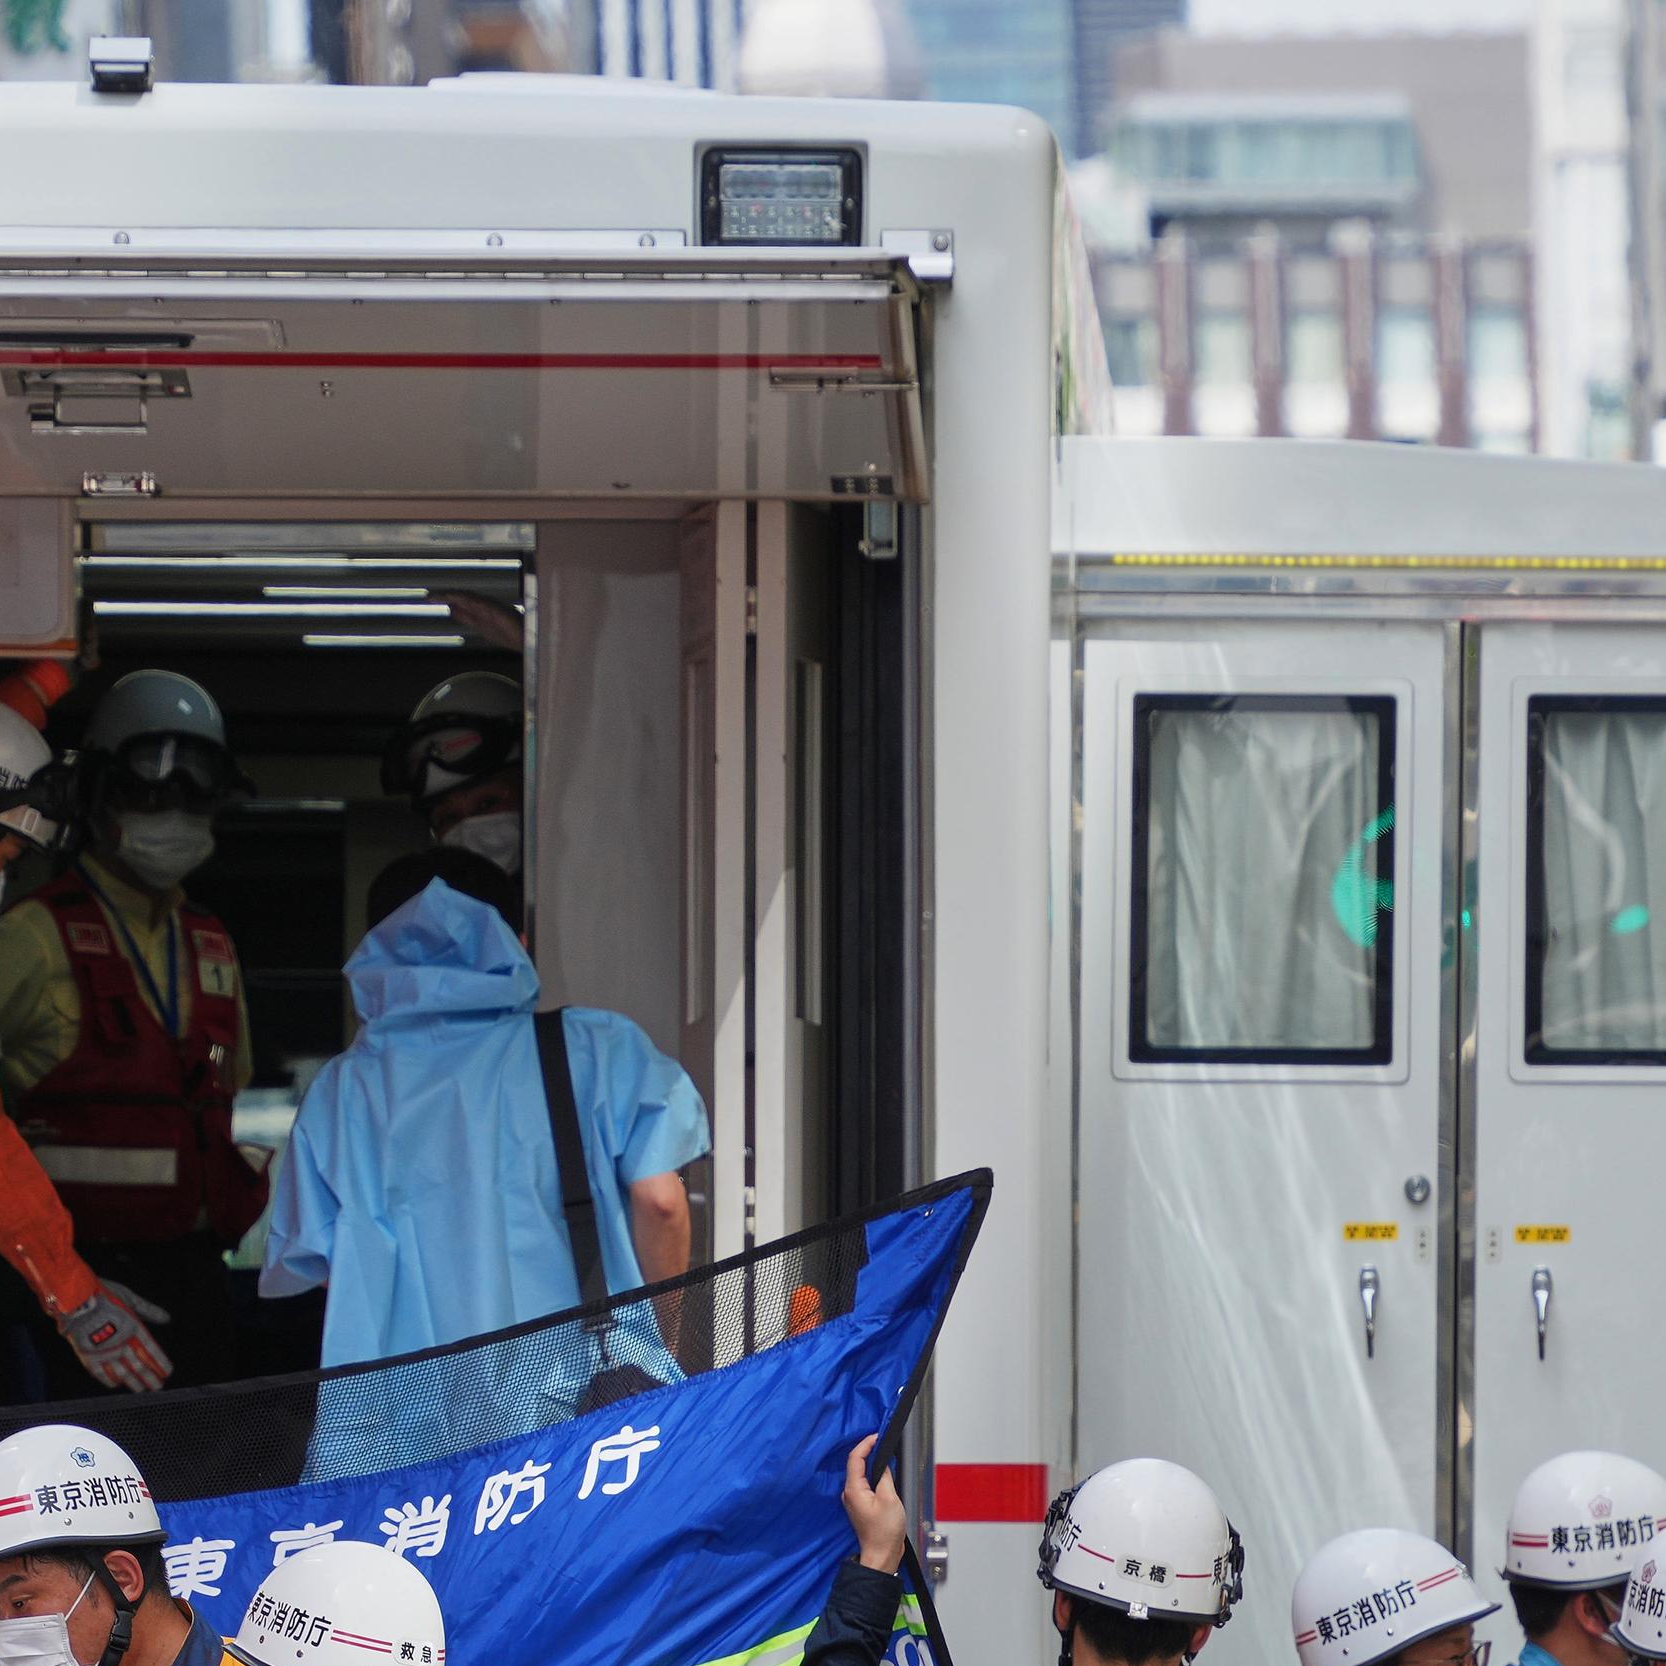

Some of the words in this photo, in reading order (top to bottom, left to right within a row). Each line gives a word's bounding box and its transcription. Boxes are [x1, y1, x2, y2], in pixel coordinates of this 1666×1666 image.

[34, 1474, 141, 1516] 東京消防庁
[1551, 1514, 1656, 1554] 東京消防庁
[1122, 1558, 1167, 1584] 京橋
[1212, 1551, 1230, 1586] 東
[247, 1589, 332, 1648] 東京消防庁
[1315, 1579, 1417, 1646] 東京消防庁
[399, 1641, 435, 1664] 救急
